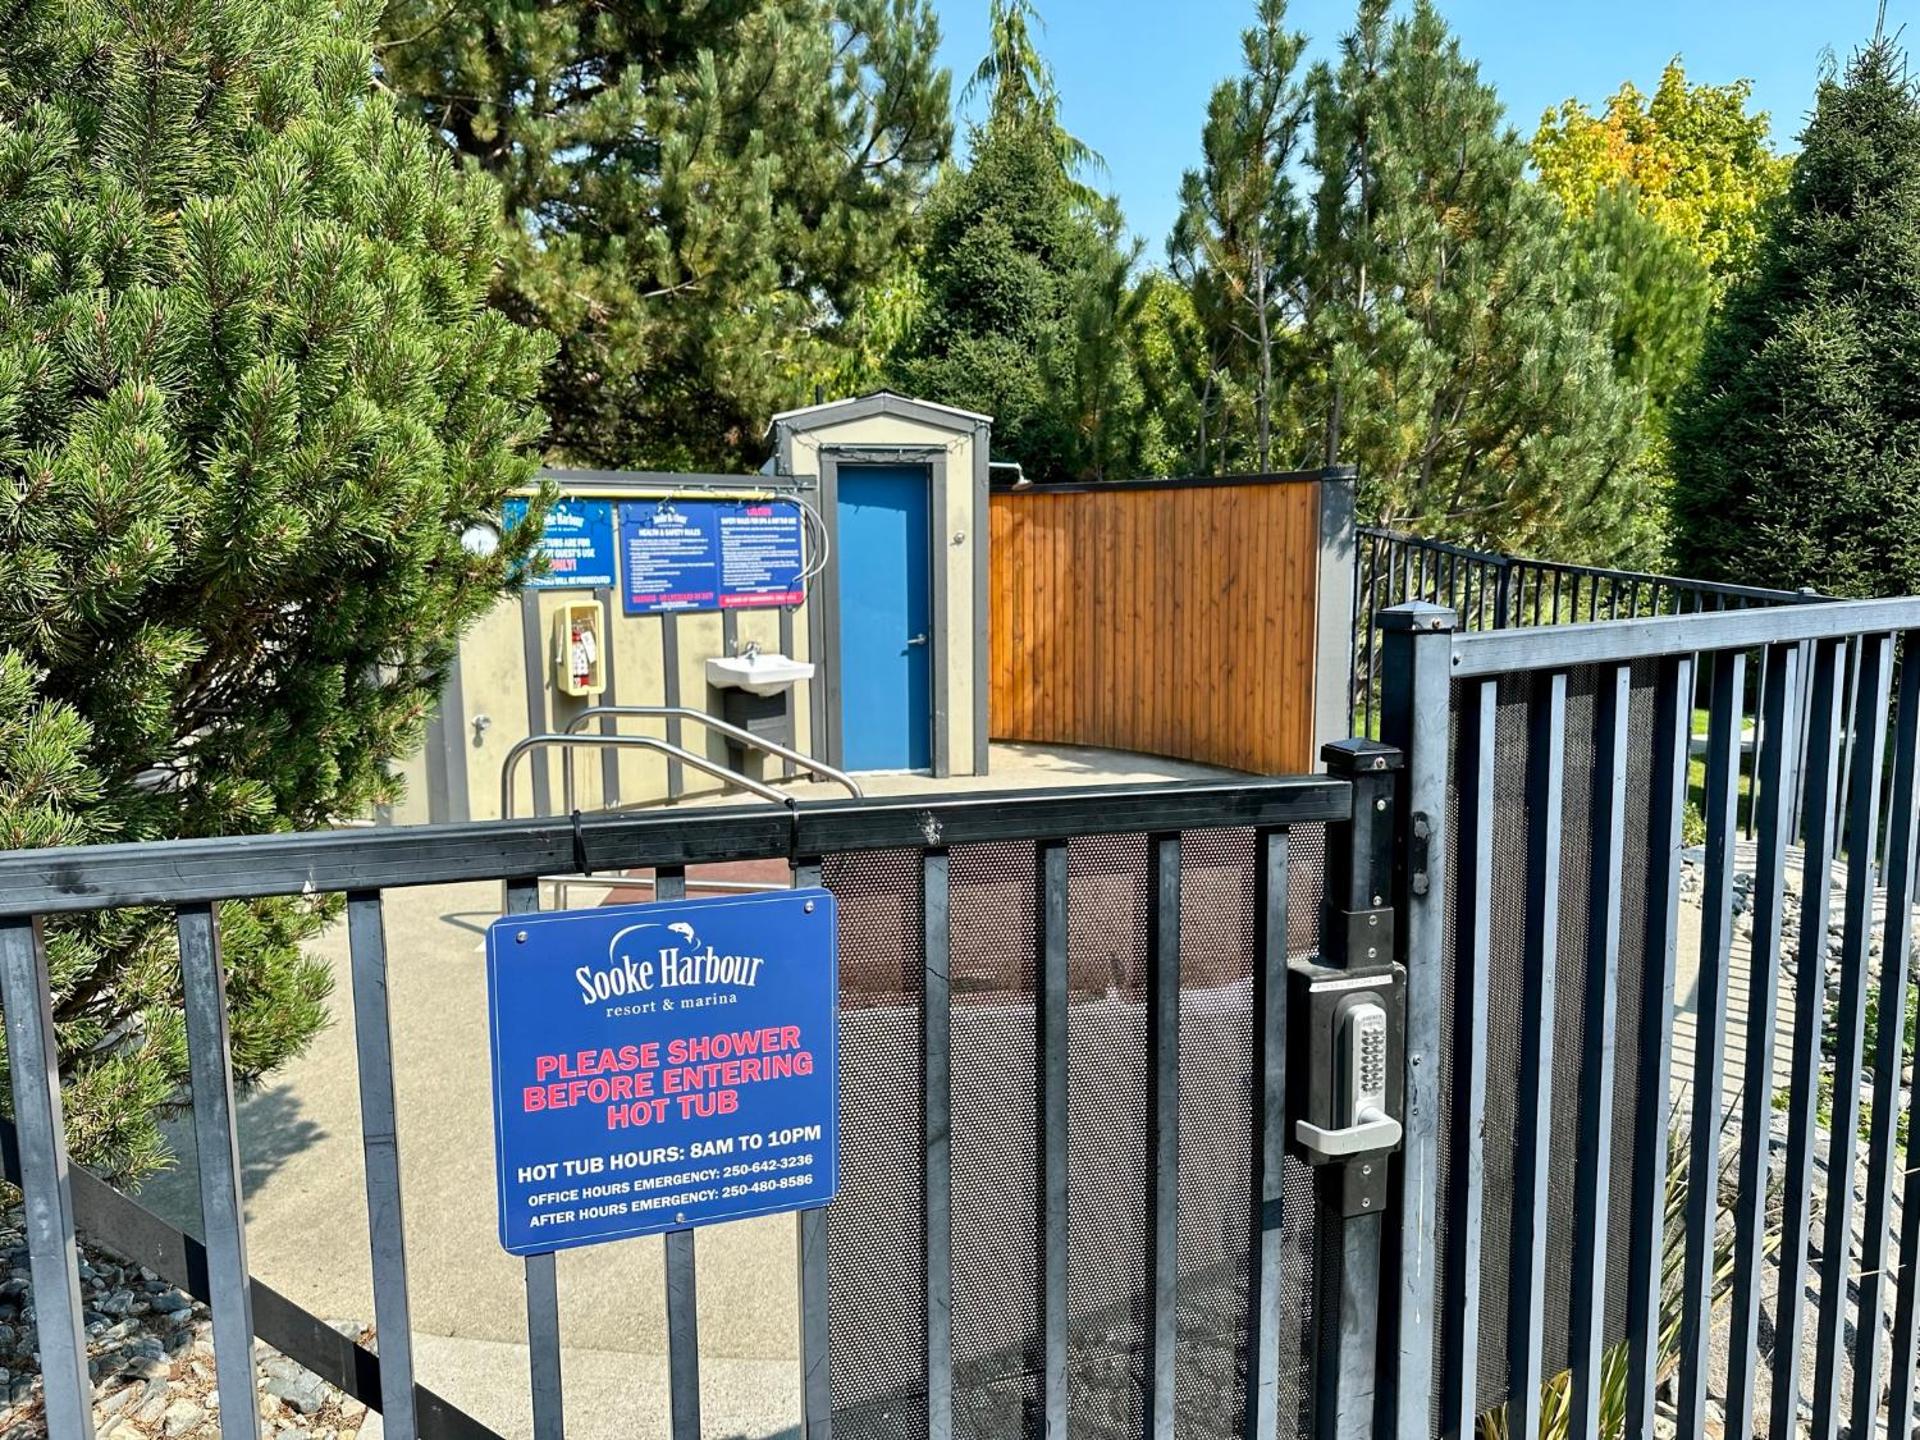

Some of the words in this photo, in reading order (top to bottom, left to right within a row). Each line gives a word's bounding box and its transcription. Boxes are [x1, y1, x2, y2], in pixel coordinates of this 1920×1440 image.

[639, 528, 659, 536] HEALTH
[665, 528, 684, 536] SAFETY
[684, 528, 701, 536] RULES
[576, 954, 654, 1005] Sooke
[659, 946, 765, 988] Harbour
[606, 1000, 657, 1018] resort
[662, 998, 674, 1011] &
[681, 993, 737, 1009] marina
[536, 1042, 660, 1082] PLEASE
[667, 1025, 800, 1065] SHOWER
[523, 1072, 655, 1112] BEFORE
[663, 1051, 813, 1093] ENTERING
[607, 1098, 670, 1130] HOT
[677, 1089, 739, 1120] TUB
[517, 1163, 558, 1184] HOT
[563, 1157, 604, 1177] TUB
[610, 1146, 685, 1170] HOURS:
[690, 1136, 733, 1159] 8AM
[738, 1132, 763, 1152] TO
[768, 1124, 822, 1147] 10PM
[528, 1189, 579, 1208] OFFICE
[582, 1181, 630, 1198] HOURS
[634, 1168, 720, 1192] EMERGENCY:
[723, 1153, 814, 1177] 250-642-3236
[529, 1211, 577, 1228] AFTER
[579, 1203, 628, 1219] HOURS
[631, 1188, 719, 1212] EMERGENCY:
[721, 1173, 814, 1198] 250-480-8586
